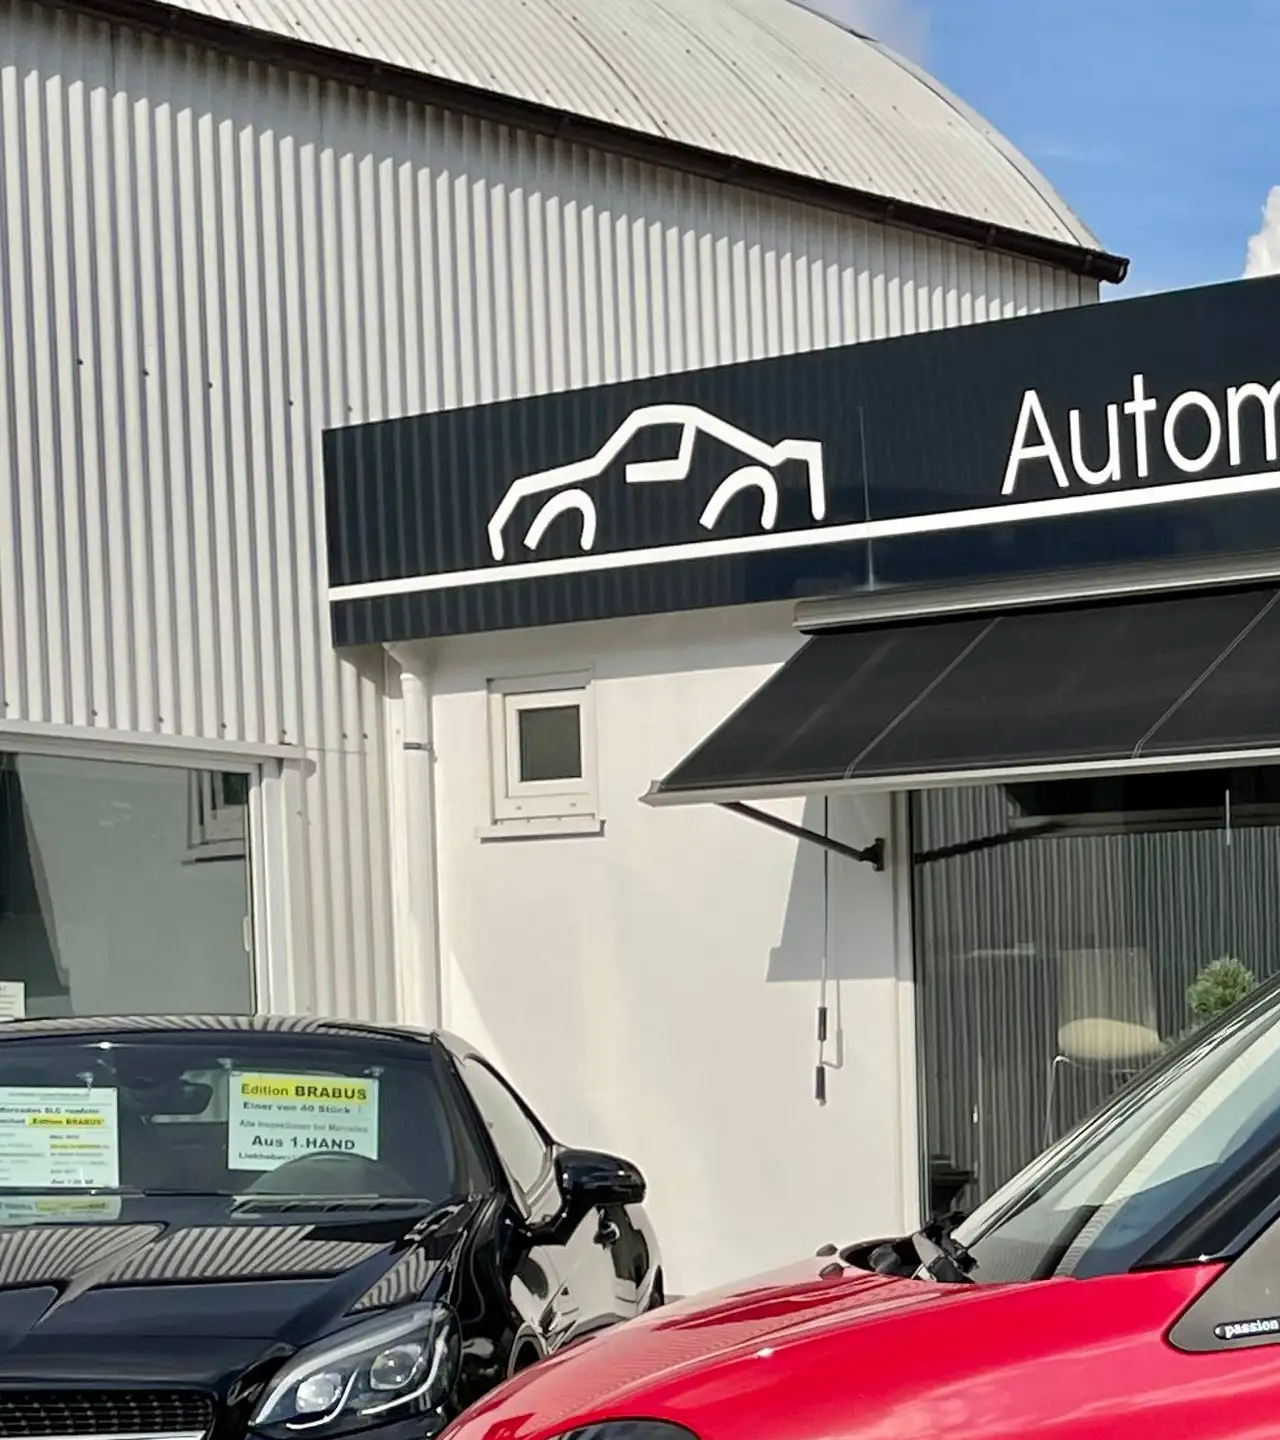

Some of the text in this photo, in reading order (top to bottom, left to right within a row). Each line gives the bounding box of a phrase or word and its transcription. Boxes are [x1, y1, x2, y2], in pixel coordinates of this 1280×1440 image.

[241, 1083, 367, 1100] Edition BRABUS
[243, 1101, 272, 1111] Einer
[252, 1135, 356, 1150] Aus 1.HAND
[1224, 1318, 1279, 1339] passion
